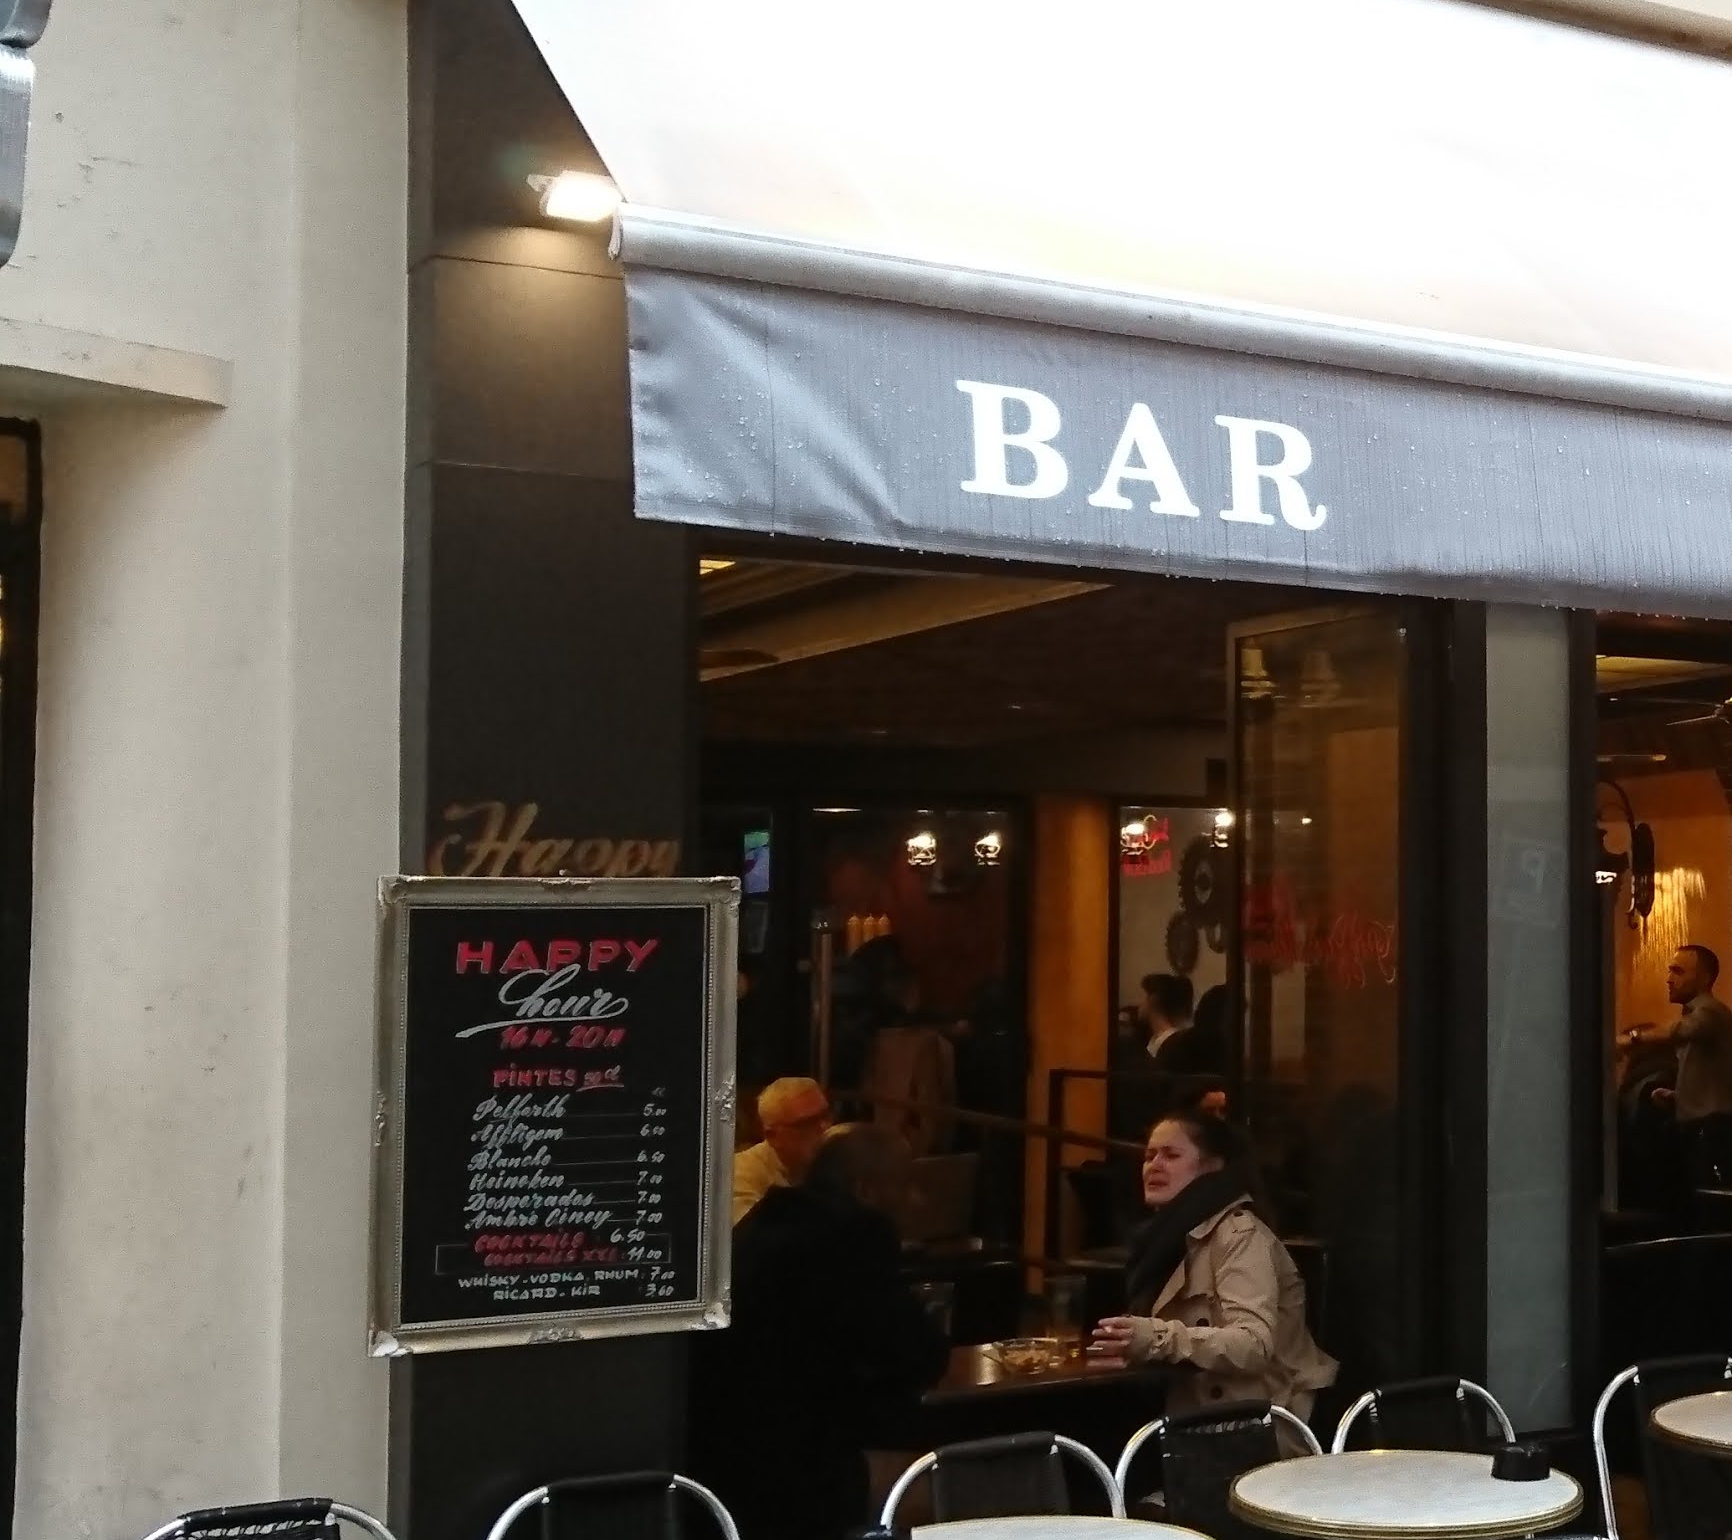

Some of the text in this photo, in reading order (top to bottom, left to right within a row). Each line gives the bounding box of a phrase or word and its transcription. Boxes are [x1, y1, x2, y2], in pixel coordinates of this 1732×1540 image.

[956, 379, 1328, 532] BAR
[457, 939, 657, 974] HAPPY
[468, 1169, 565, 1192] Heineken
